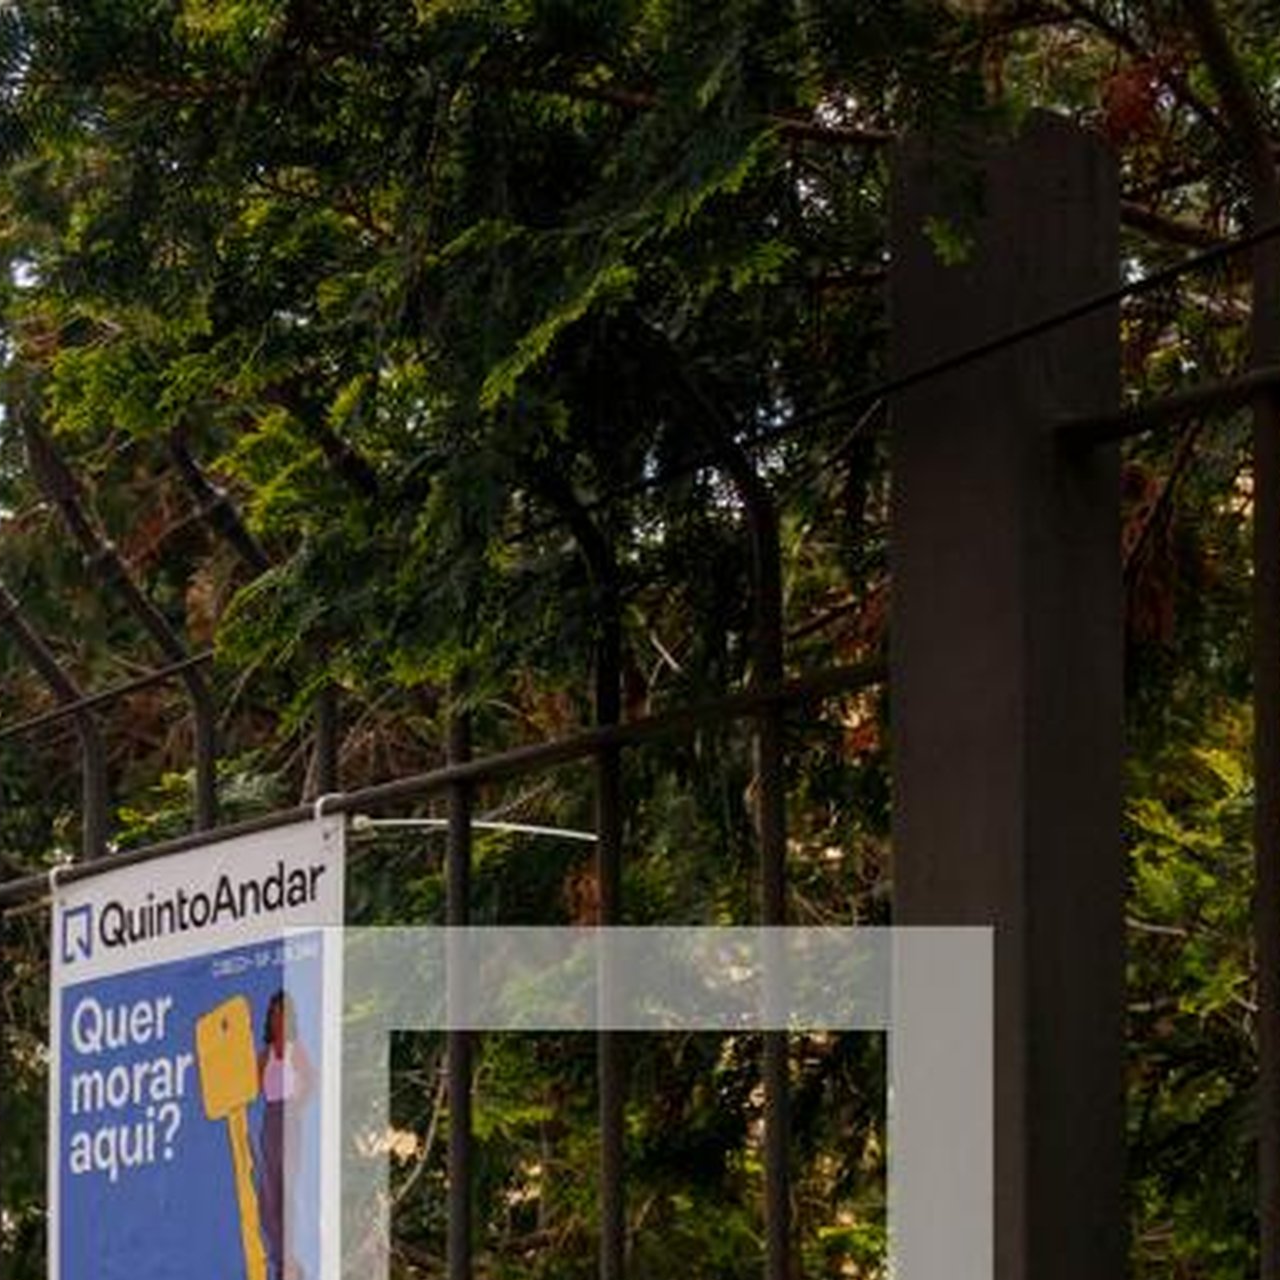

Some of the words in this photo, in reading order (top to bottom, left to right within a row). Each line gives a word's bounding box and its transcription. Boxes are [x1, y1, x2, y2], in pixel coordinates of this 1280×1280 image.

[99, 861, 325, 948] QuintoAndar
[71, 996, 173, 1055] Quer
[71, 1052, 193, 1115] morar
[70, 1101, 182, 1182] aqui?
